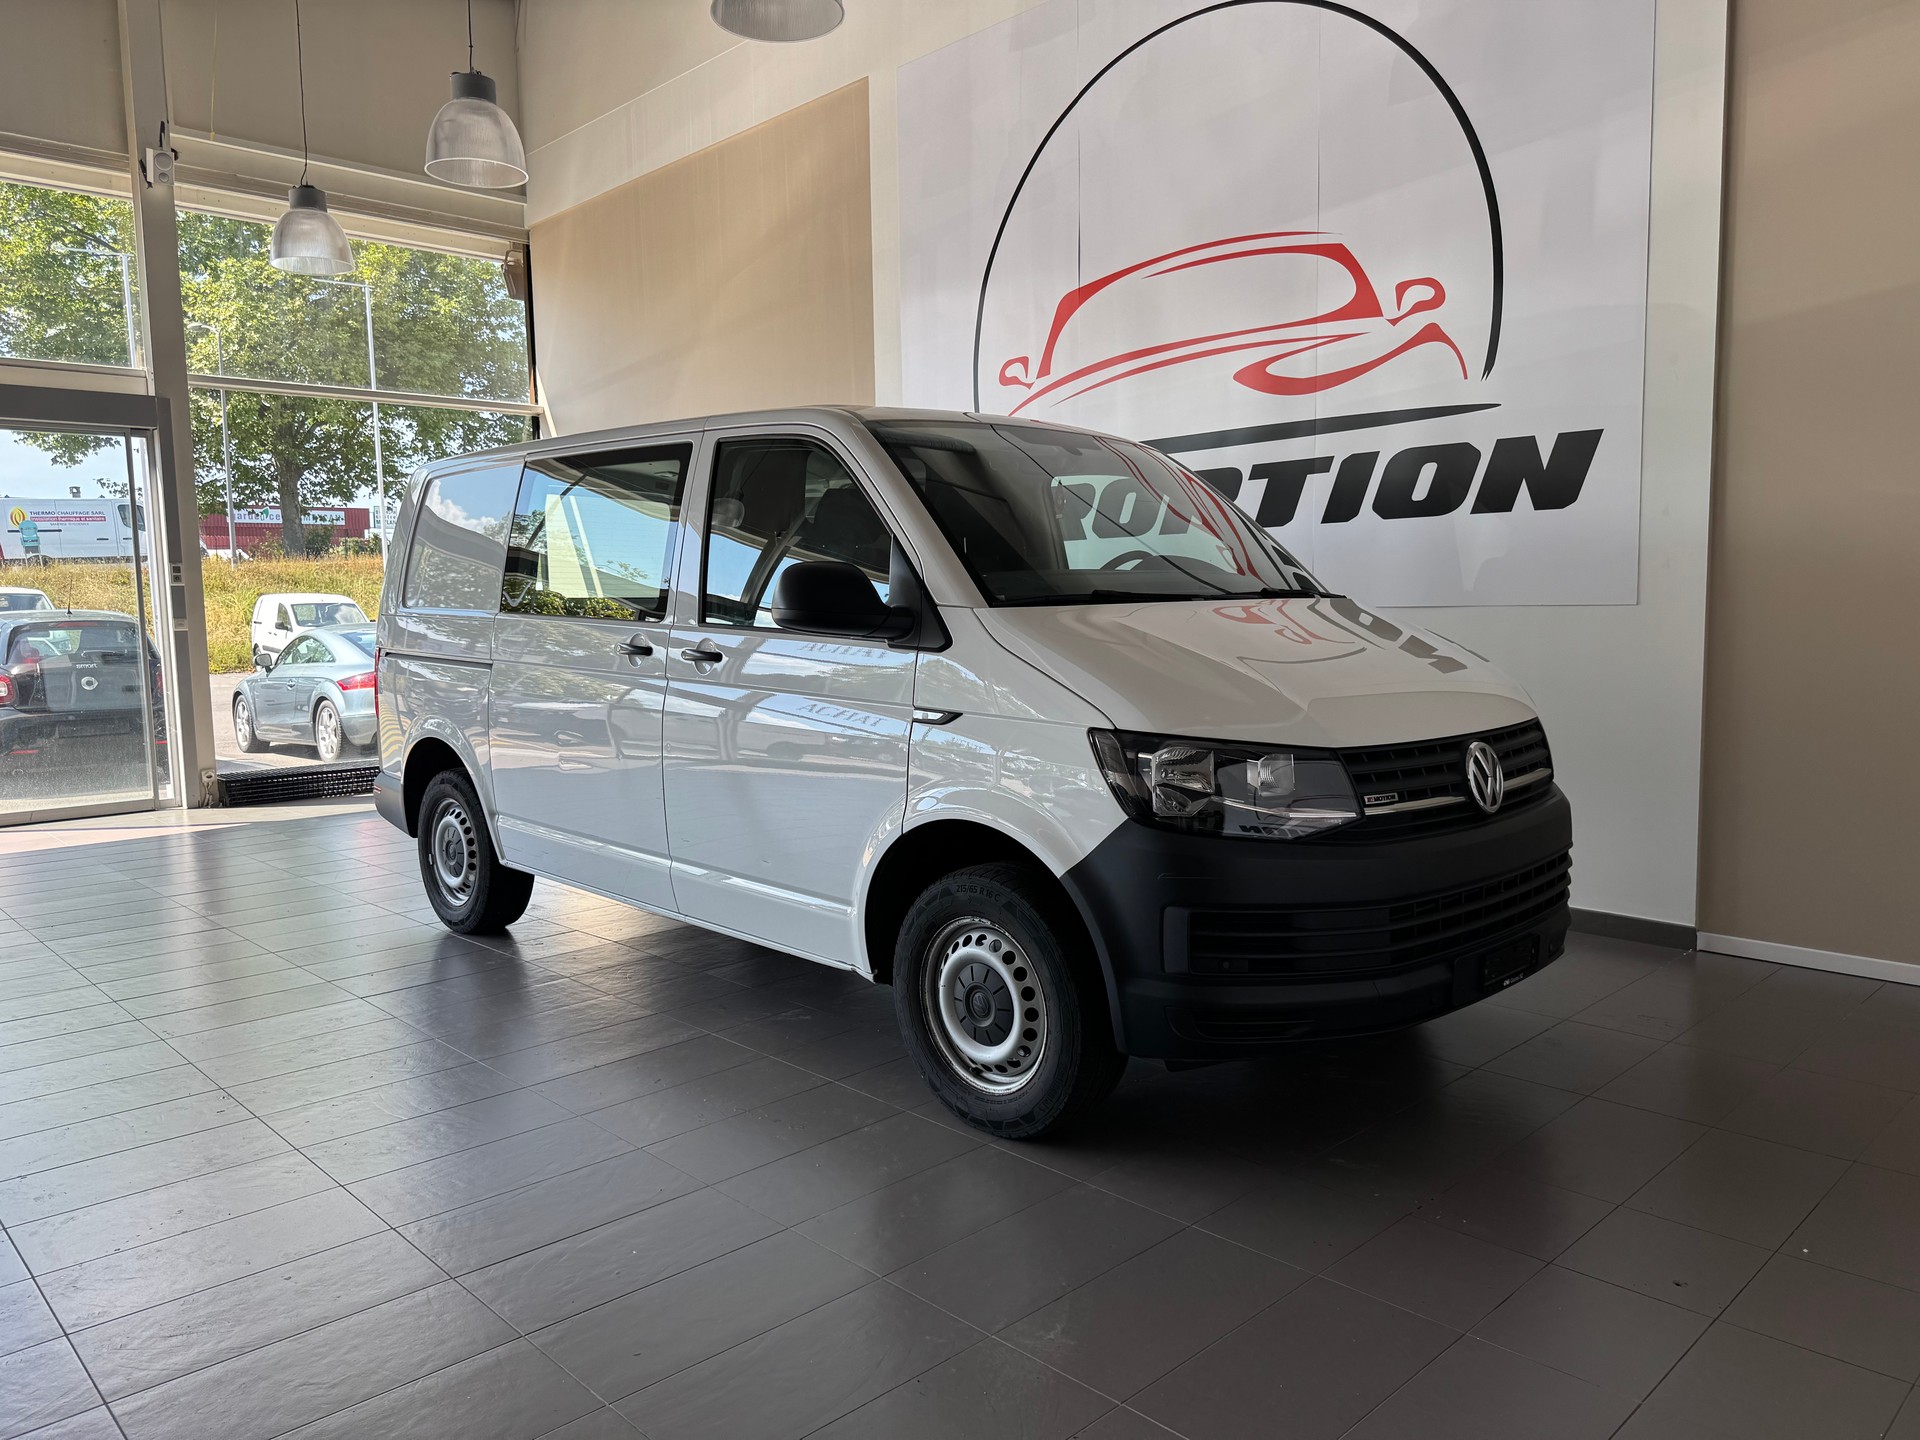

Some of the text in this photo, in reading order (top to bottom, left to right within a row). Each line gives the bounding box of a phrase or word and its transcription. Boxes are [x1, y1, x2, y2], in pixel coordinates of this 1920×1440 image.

[956, 884, 1001, 903] 215/65 R 16 C
